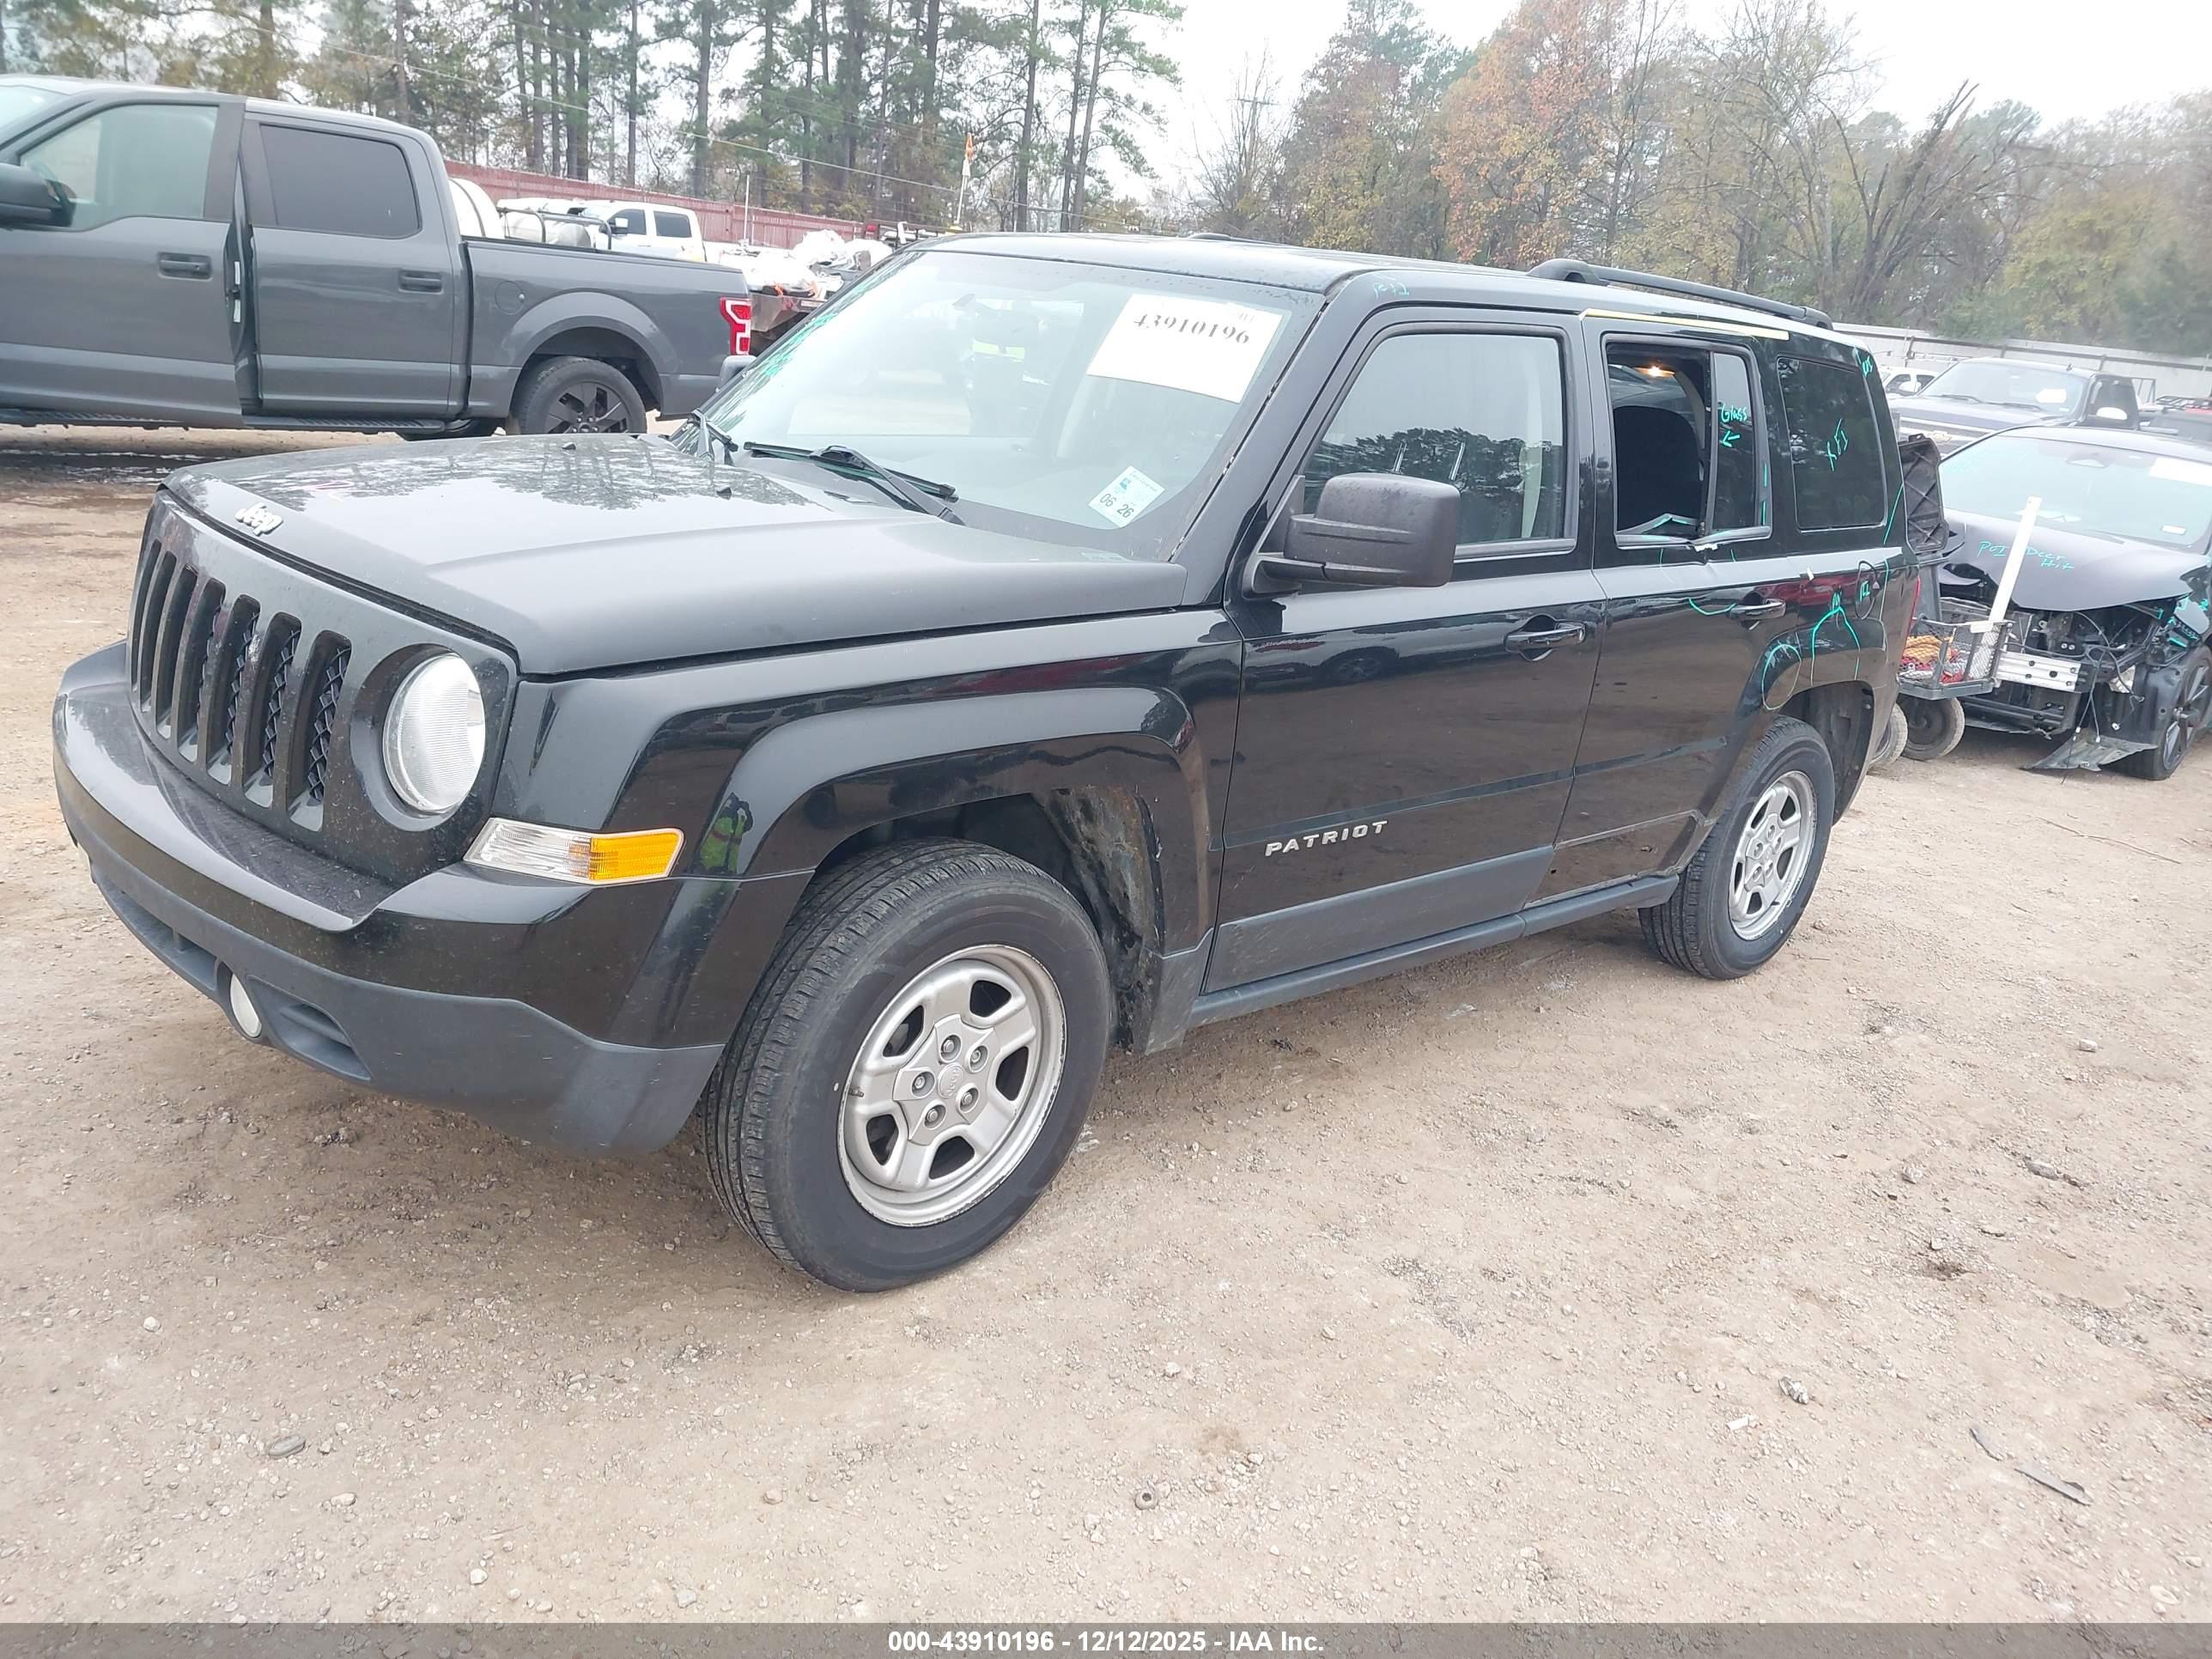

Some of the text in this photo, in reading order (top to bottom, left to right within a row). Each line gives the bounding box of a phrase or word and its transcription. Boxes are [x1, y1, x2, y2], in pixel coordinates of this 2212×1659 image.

[1133, 313, 1249, 344] 43910196
[1100, 493, 1134, 518] 06 26
[1265, 820, 1388, 857] PATRIOT
